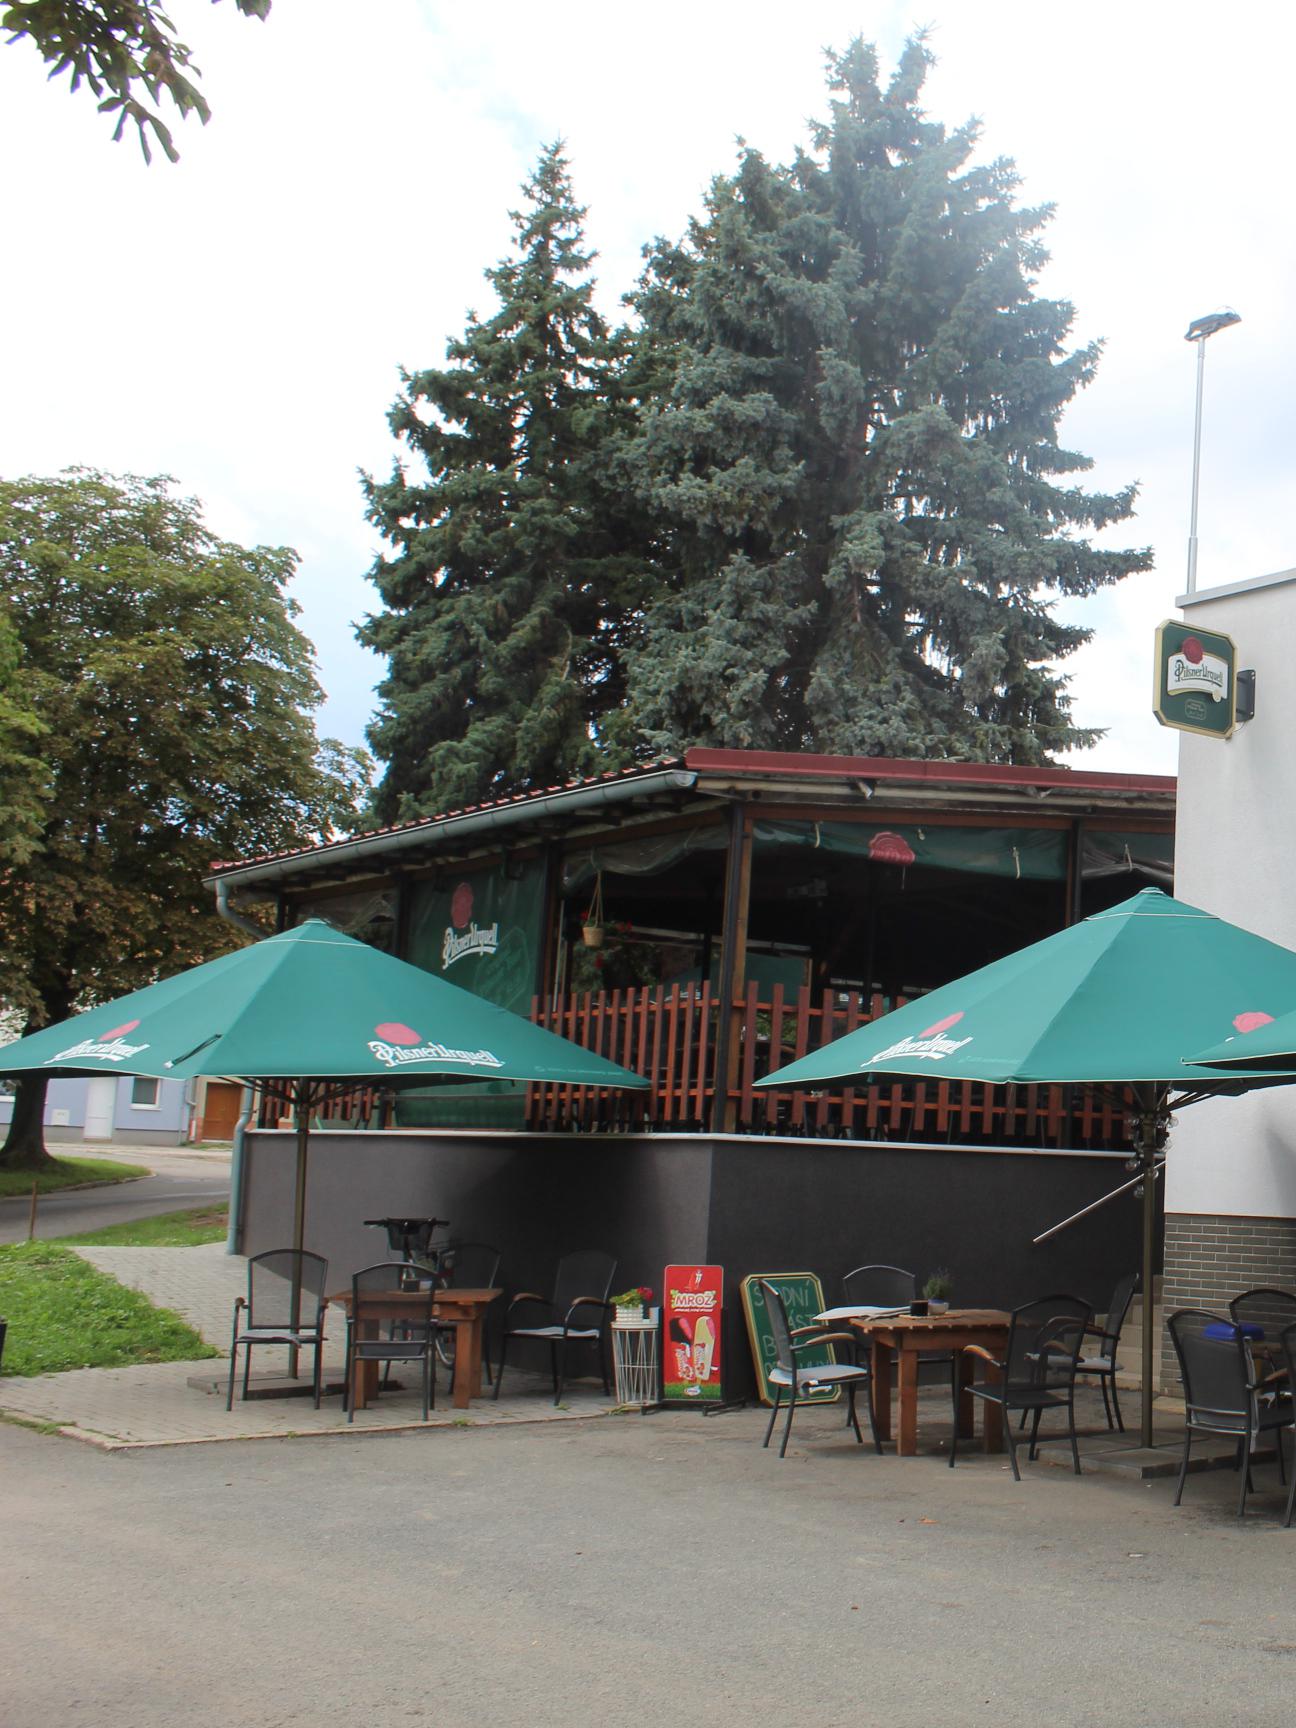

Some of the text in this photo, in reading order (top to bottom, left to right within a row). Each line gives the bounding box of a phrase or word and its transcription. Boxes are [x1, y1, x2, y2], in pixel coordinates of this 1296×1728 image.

[1174, 659, 1203, 682] Pilsner
[367, 1041, 500, 1067] Pilsner Urquell
